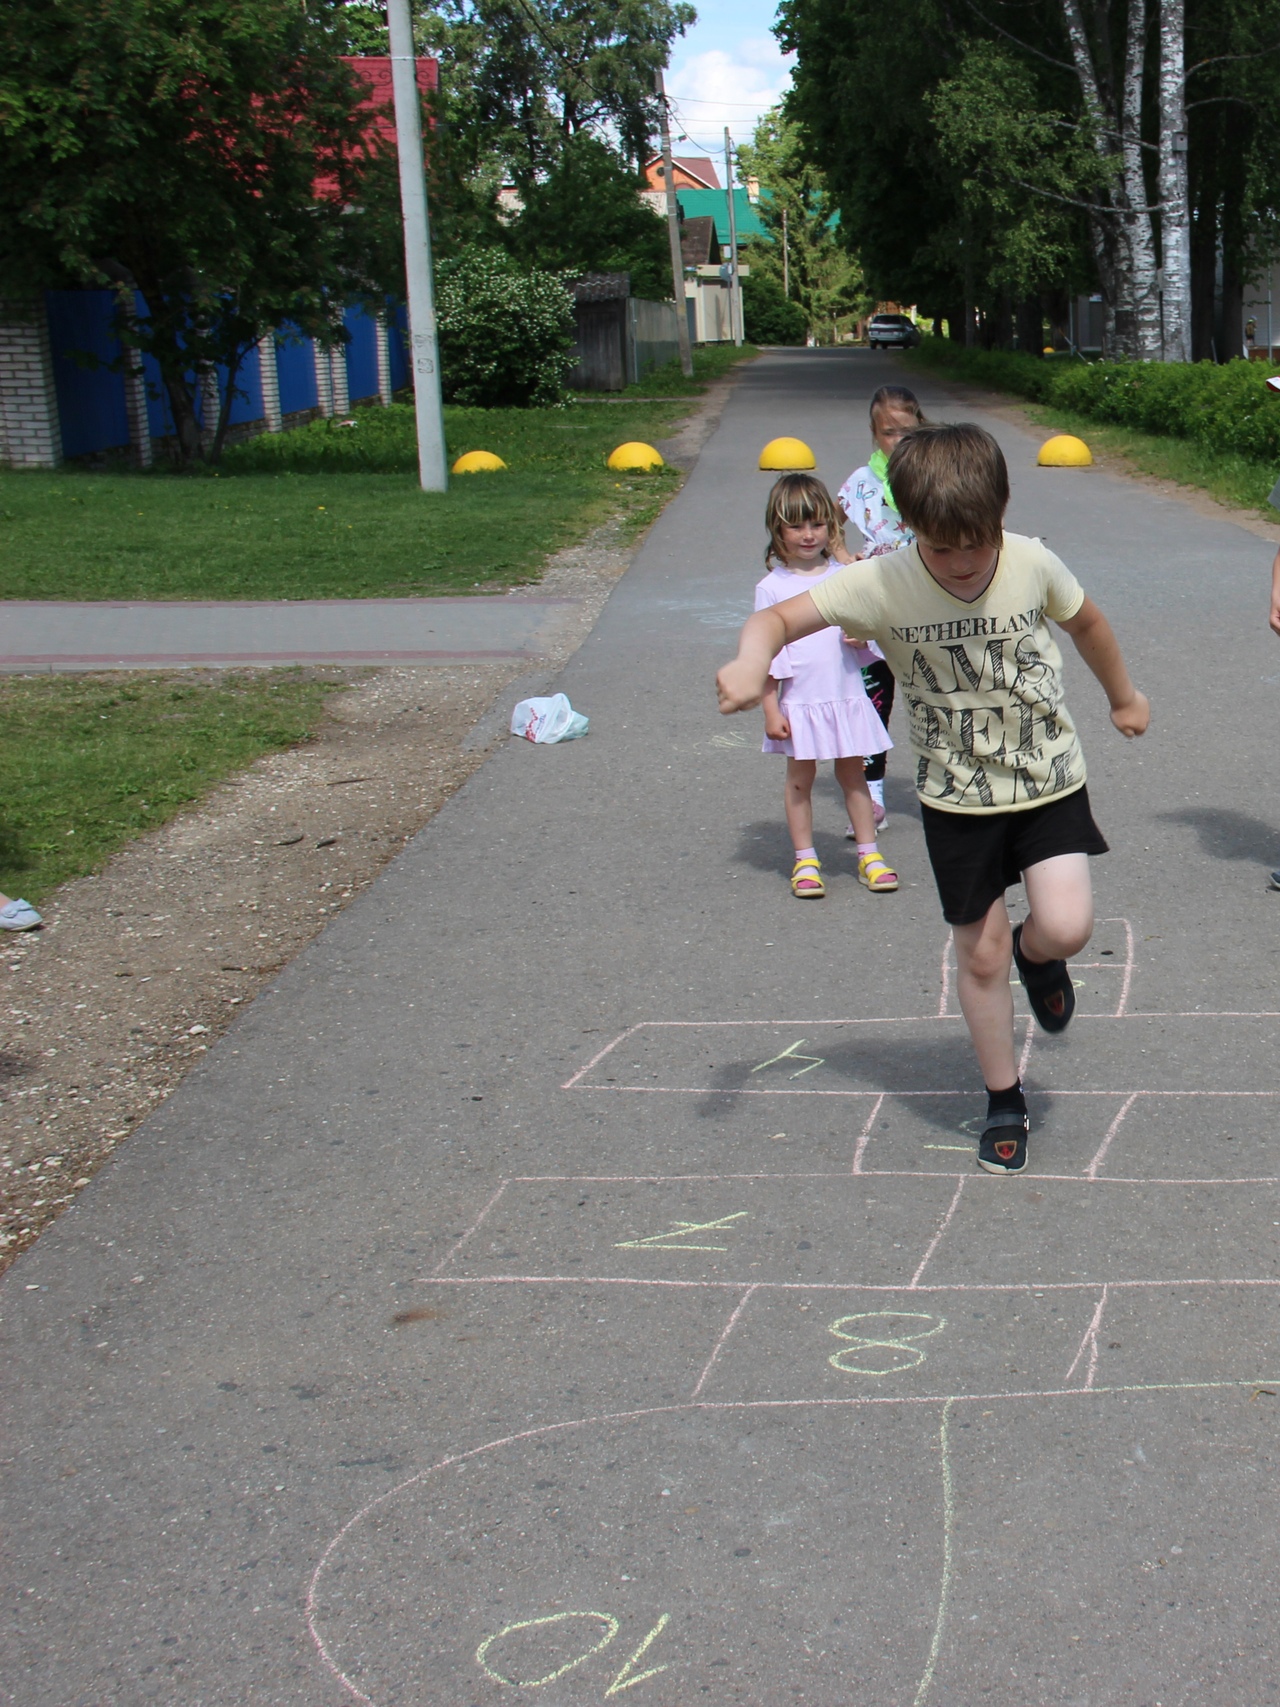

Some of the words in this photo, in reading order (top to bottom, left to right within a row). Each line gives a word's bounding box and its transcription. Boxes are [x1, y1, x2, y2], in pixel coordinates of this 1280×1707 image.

[890, 606, 1044, 643] NETHERLAND
[910, 634, 1055, 698] AMS
[908, 698, 1063, 757] TER
[827, 1310, 948, 1376] 8
